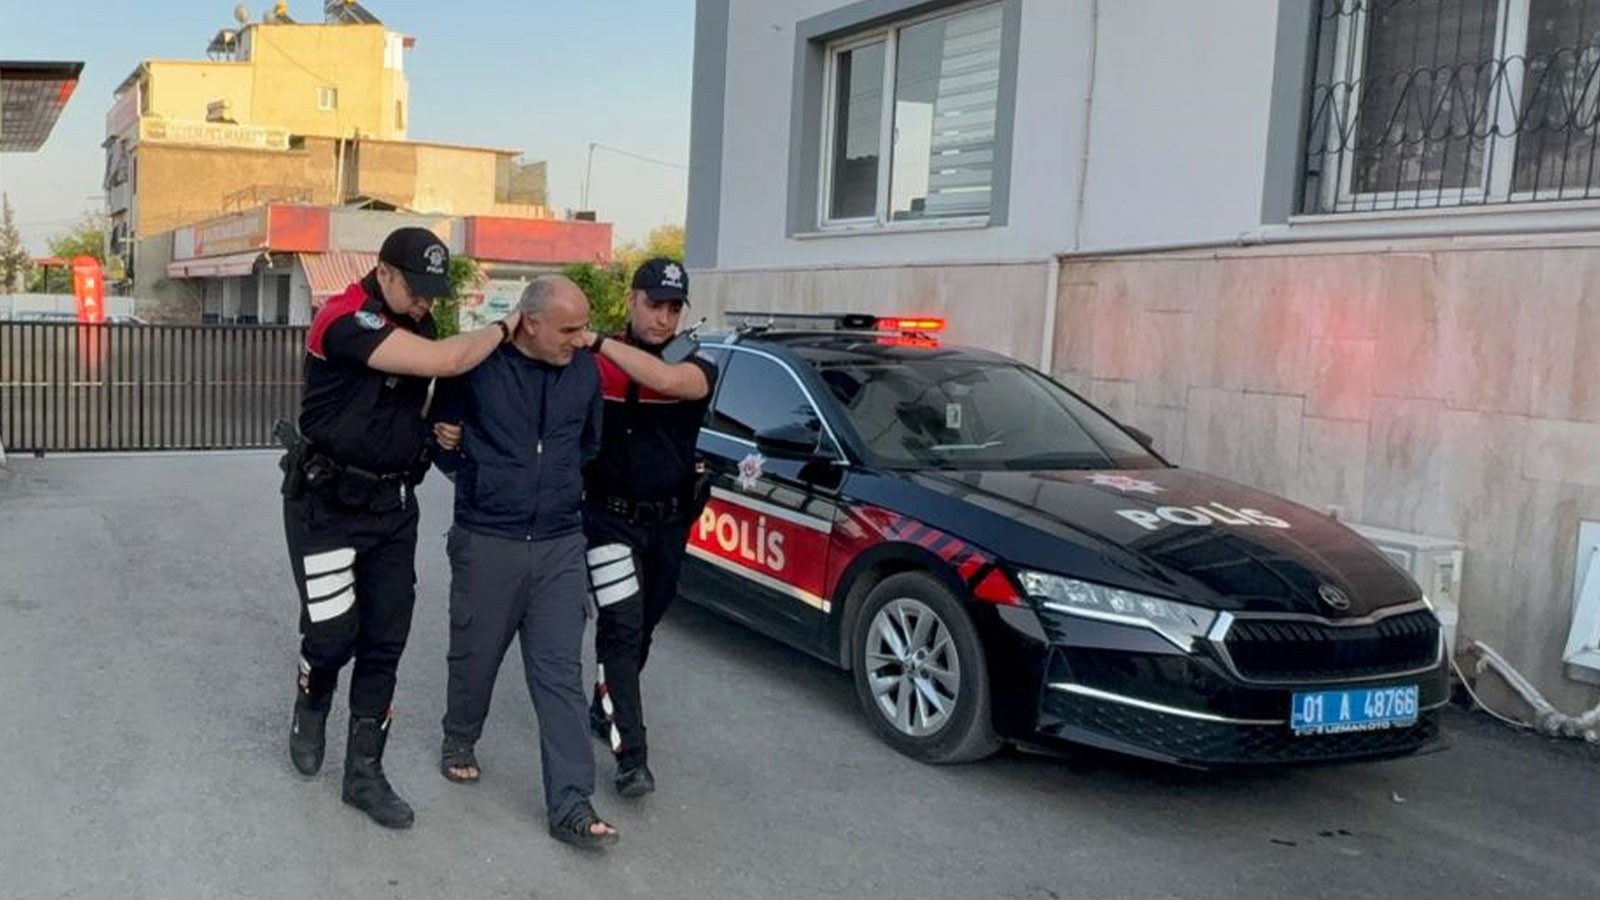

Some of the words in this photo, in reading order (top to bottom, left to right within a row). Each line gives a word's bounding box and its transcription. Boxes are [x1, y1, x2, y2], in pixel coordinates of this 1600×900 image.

[699, 506, 785, 572] POLİS
[1302, 694, 1324, 723] 01
[1339, 692, 1351, 721] A
[1363, 688, 1415, 719] 48766
